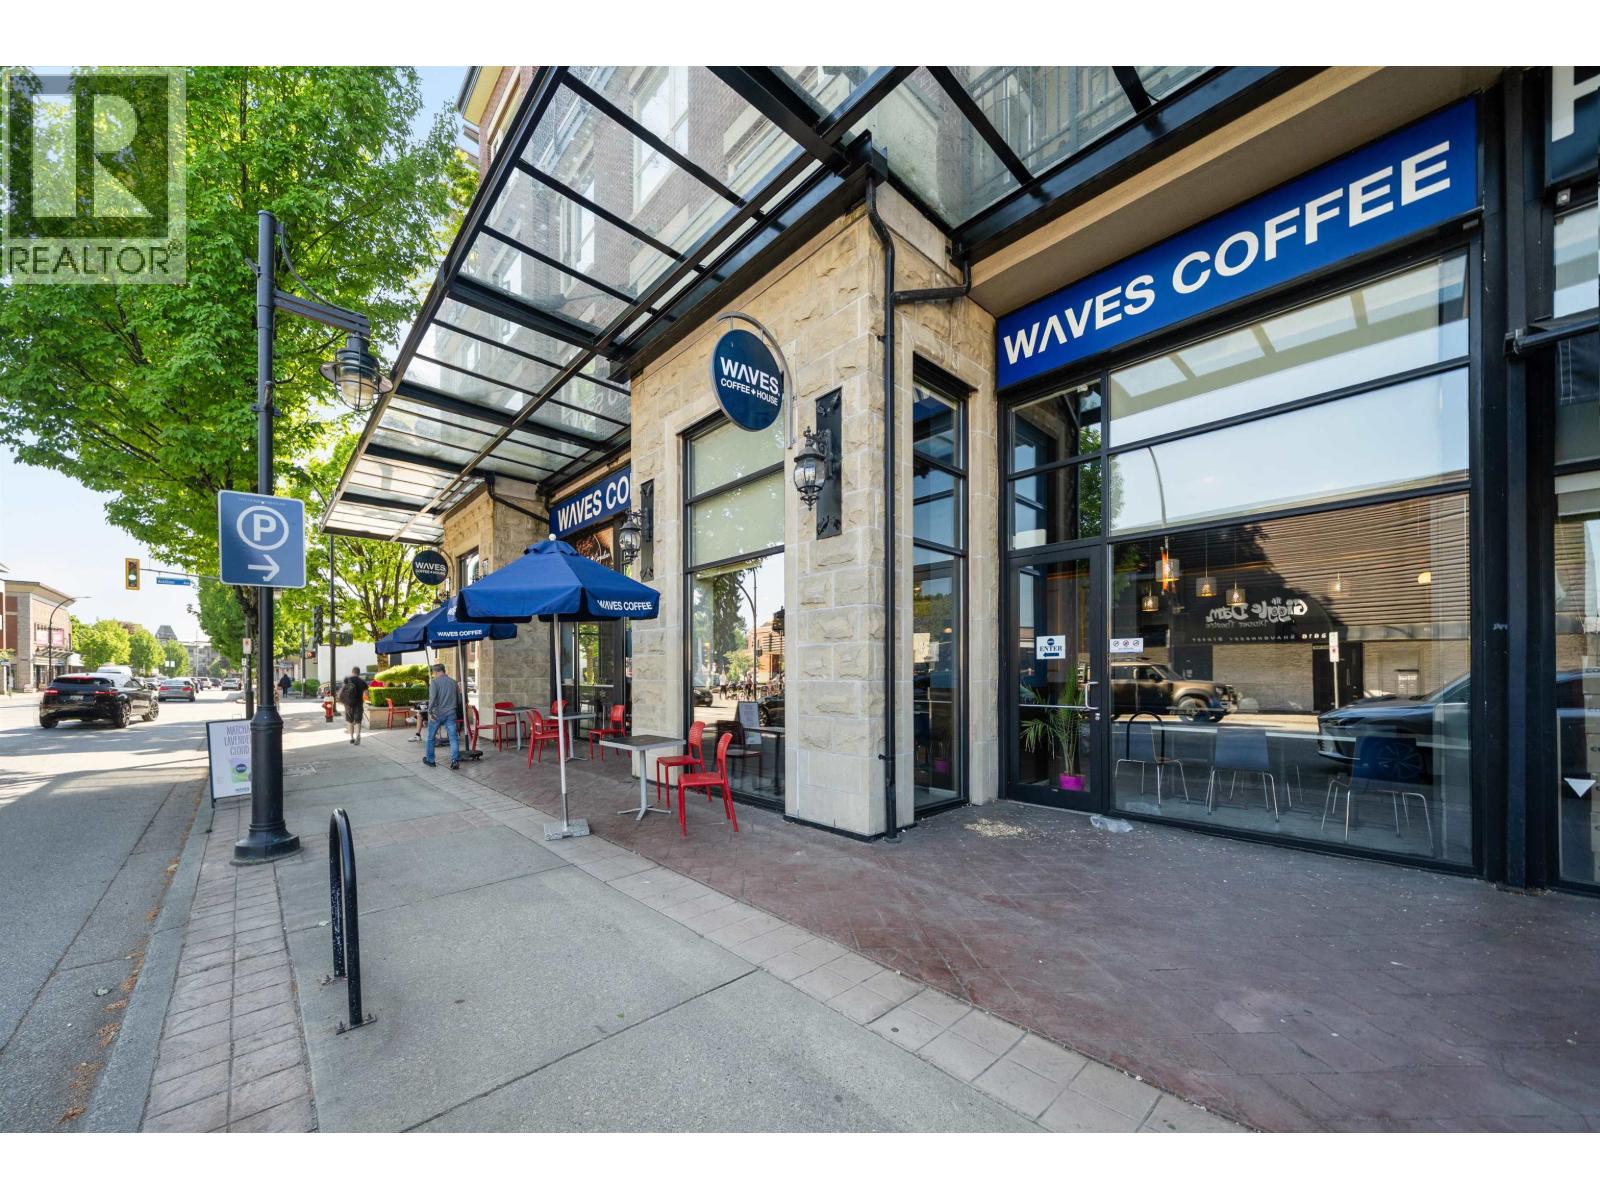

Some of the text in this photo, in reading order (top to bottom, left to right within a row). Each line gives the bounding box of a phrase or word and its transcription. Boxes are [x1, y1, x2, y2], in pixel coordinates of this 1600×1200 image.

[1003, 140, 1451, 365] WAVES COFFEE
[720, 356, 779, 395] WAVES
[720, 378, 779, 406] COFFEE HOUSE
[557, 475, 631, 532] WAVES CO
[253, 513, 277, 542] P
[415, 561, 446, 572] WAVES
[597, 599, 653, 611] WAVES COFFEE
[459, 629, 483, 637] COFFEE
[224, 735, 250, 747] LAVENDE
